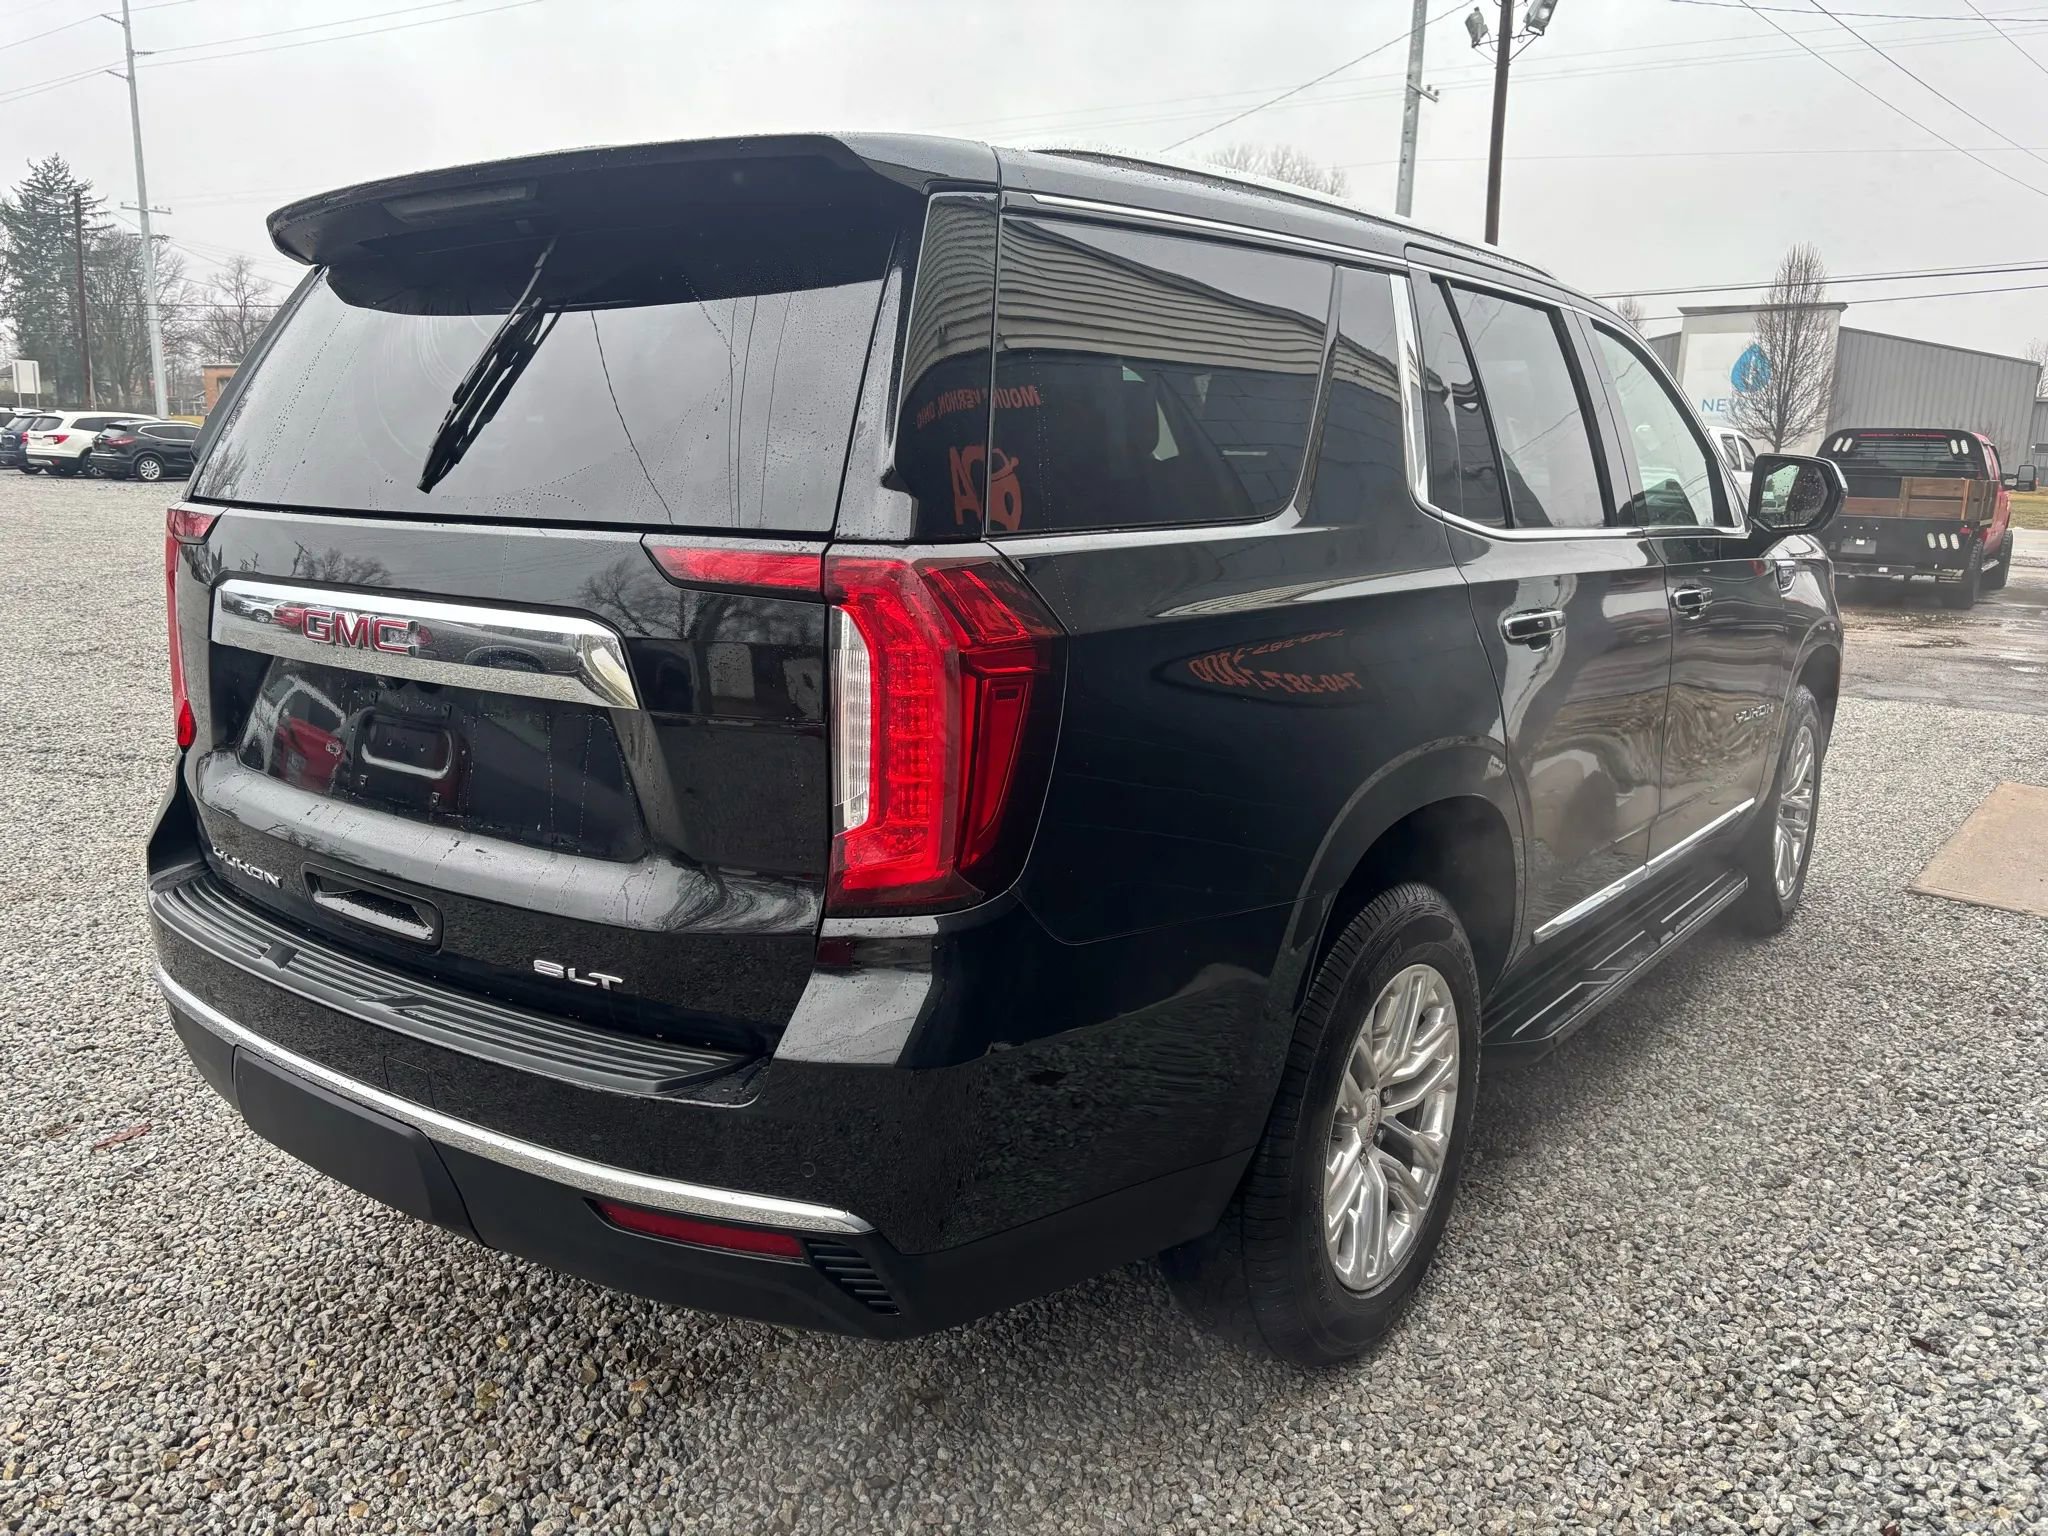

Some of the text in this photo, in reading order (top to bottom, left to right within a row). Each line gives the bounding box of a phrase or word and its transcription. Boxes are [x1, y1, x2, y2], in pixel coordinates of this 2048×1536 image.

[302, 607, 419, 657] GMC
[1735, 703, 1775, 724] YUKON
[212, 846, 281, 889] YUKON
[533, 959, 624, 990] SLT
